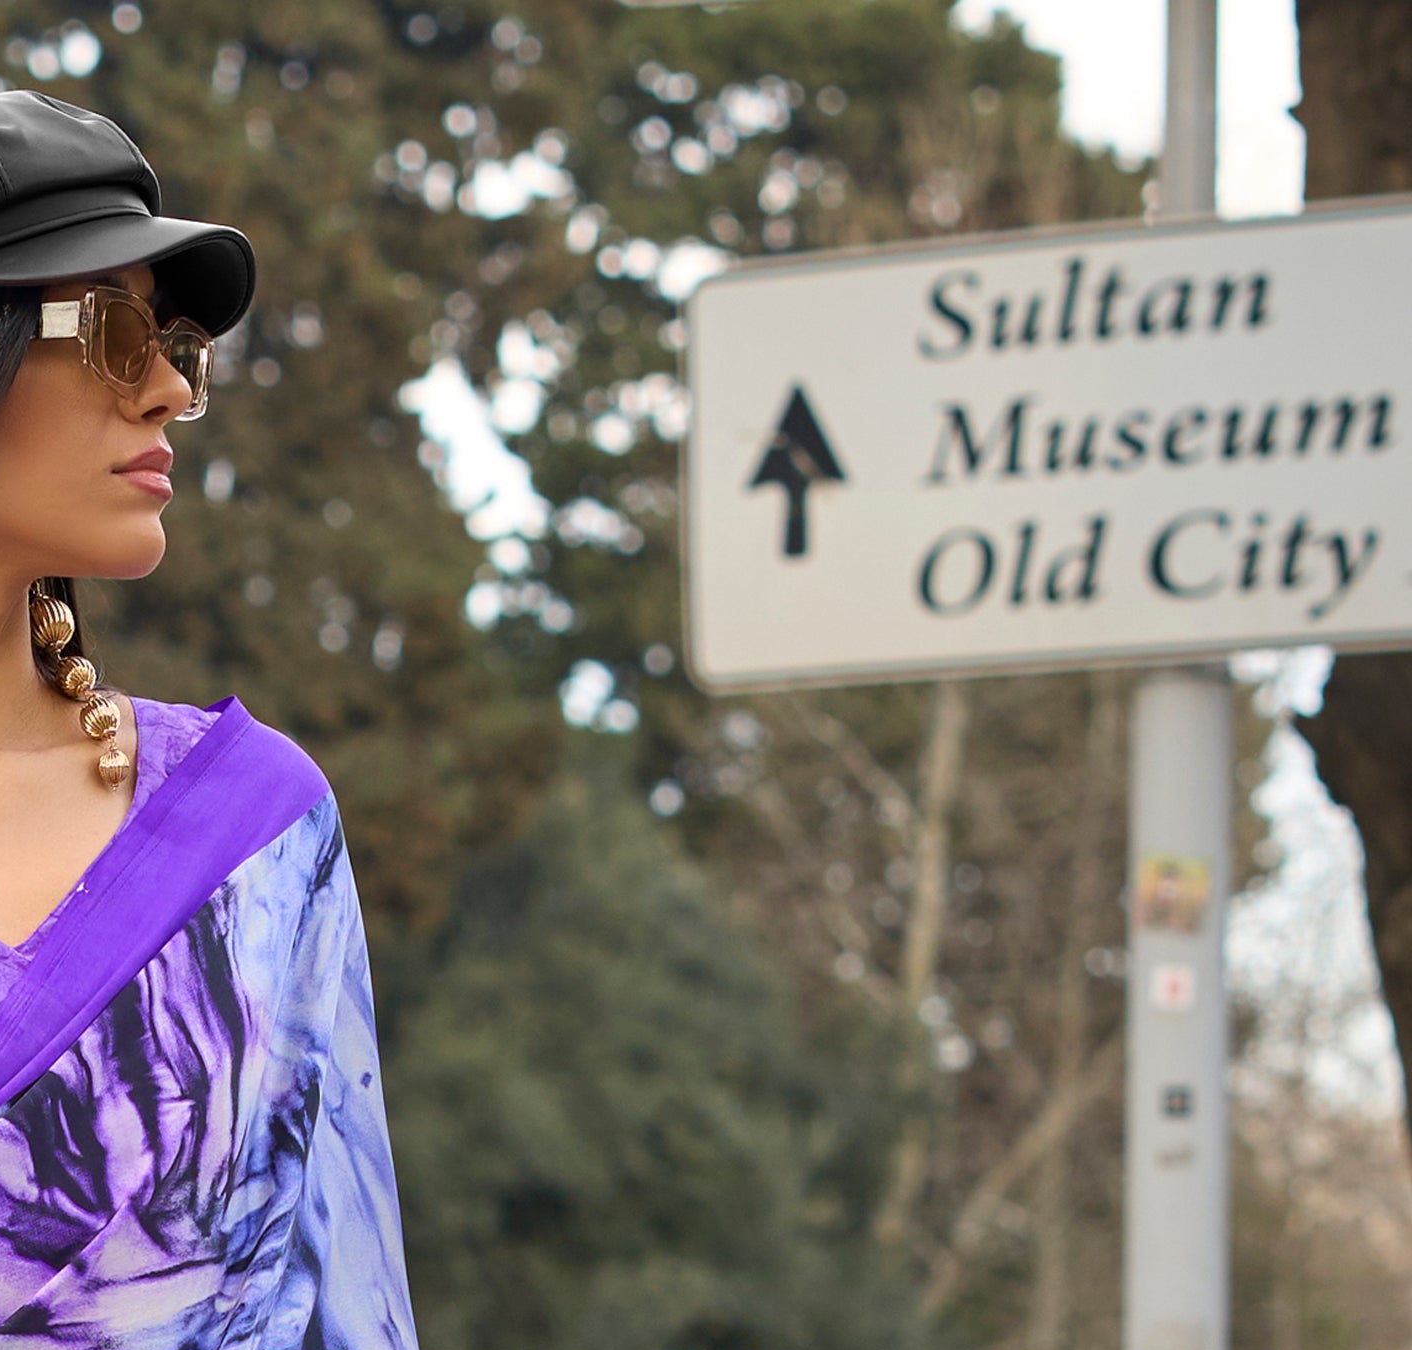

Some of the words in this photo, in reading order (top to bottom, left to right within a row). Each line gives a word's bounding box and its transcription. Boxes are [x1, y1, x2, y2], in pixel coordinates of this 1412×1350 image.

[918, 256, 1273, 360] Sultan
[923, 391, 1395, 486] Museum
[915, 514, 1108, 616] Old
[1142, 508, 1379, 619] City
